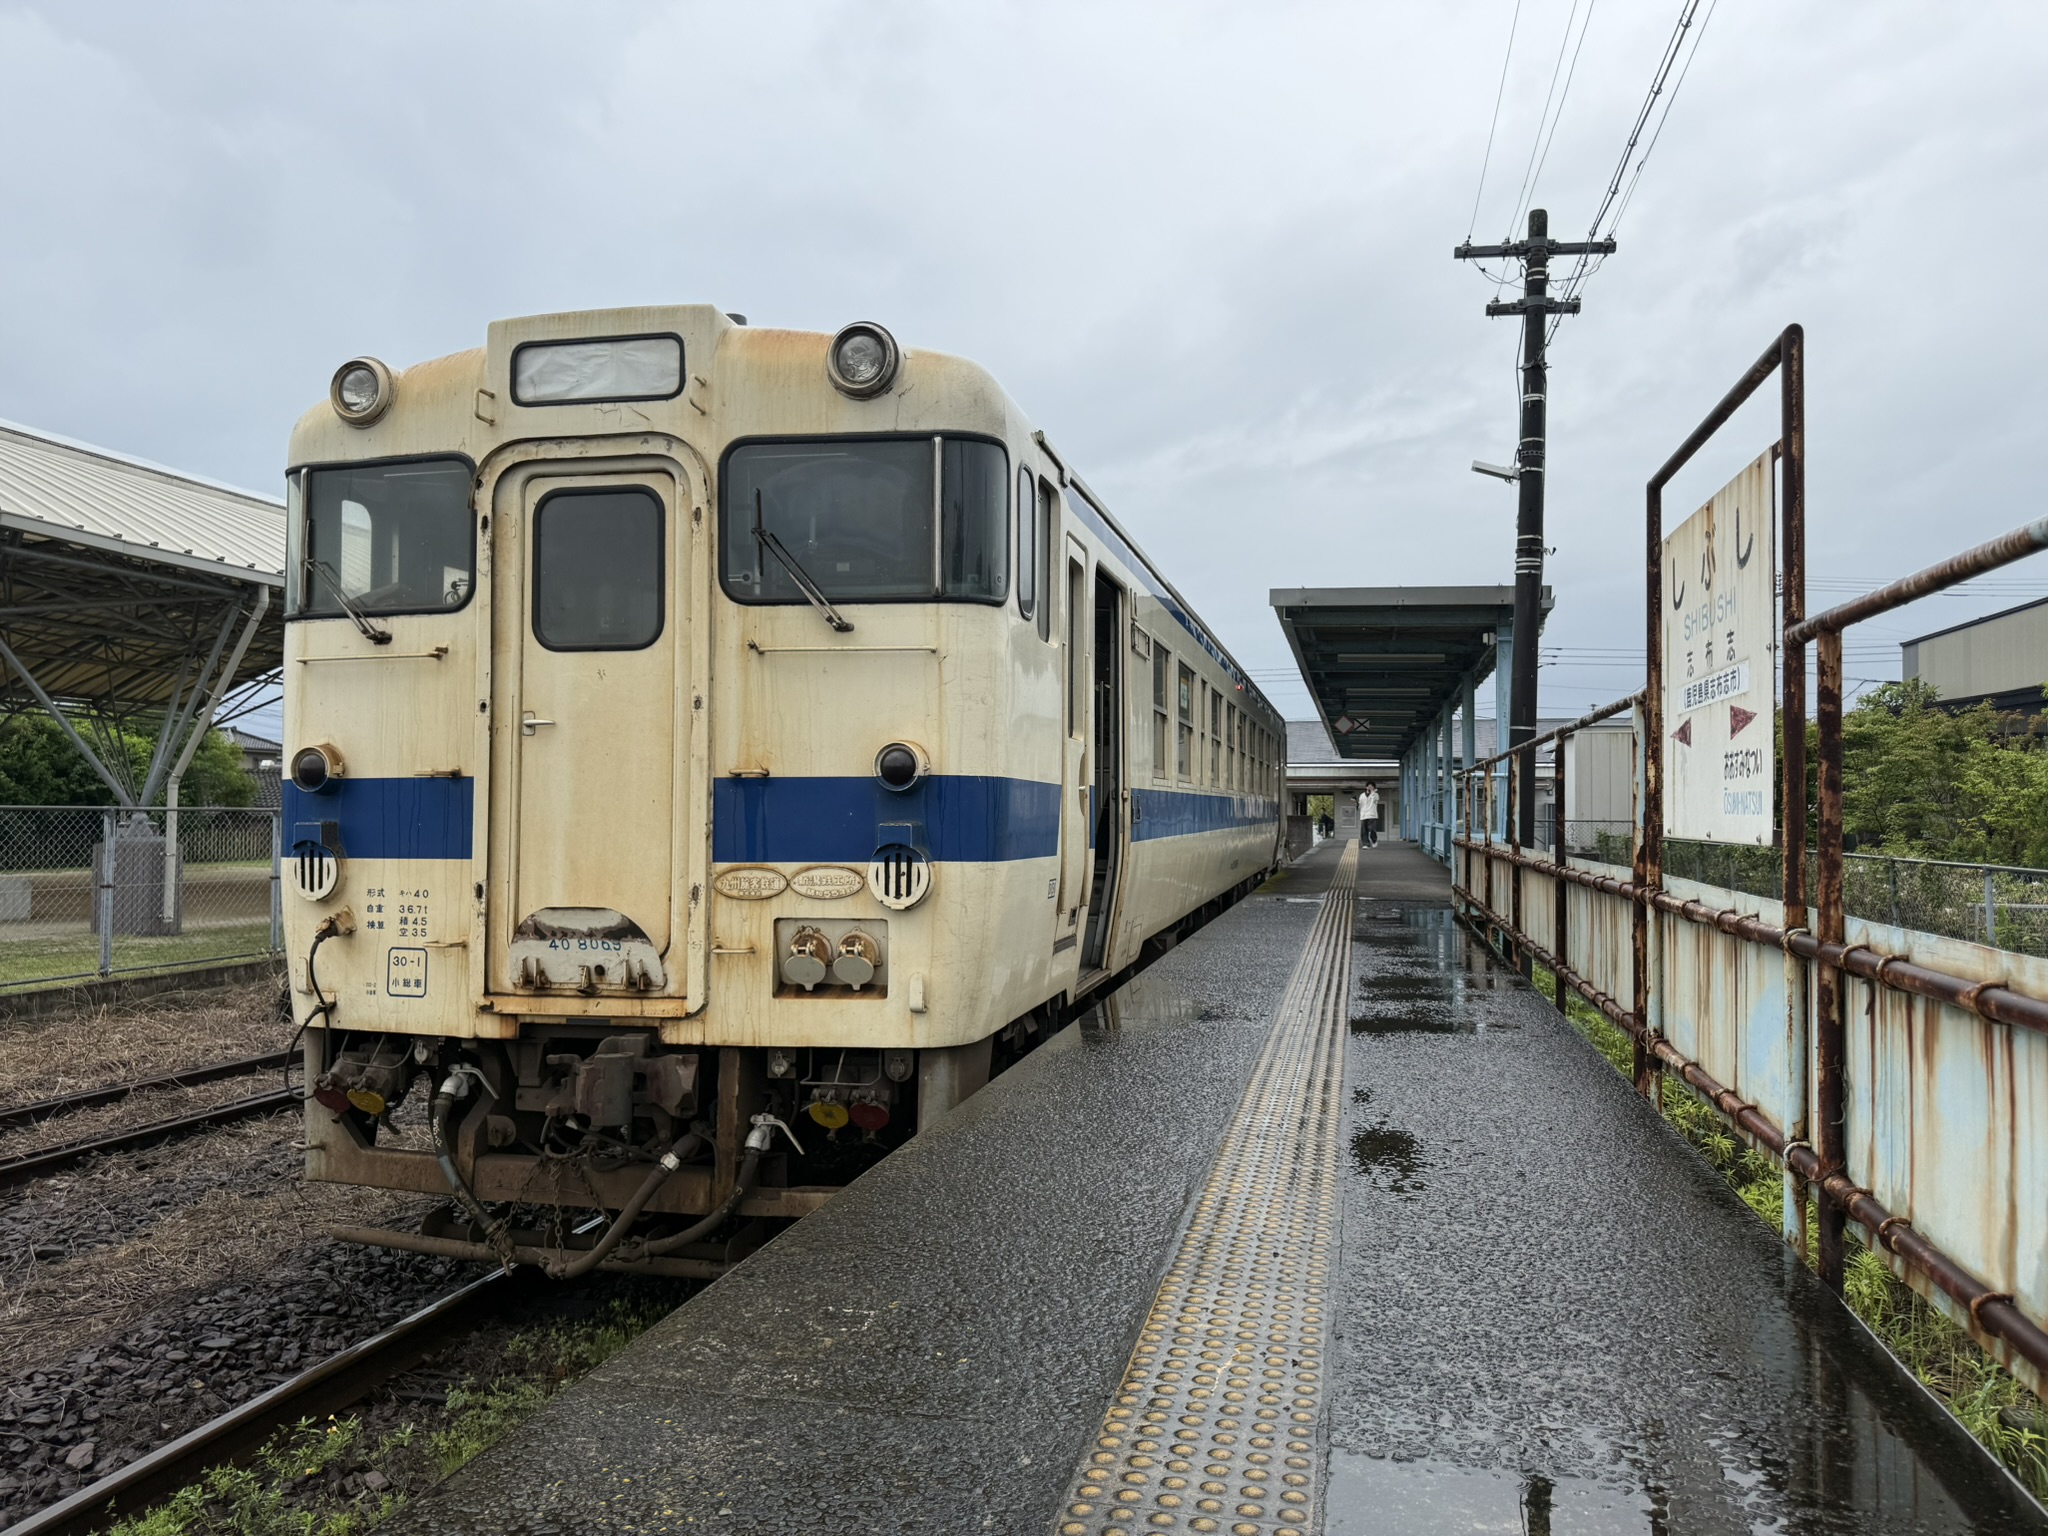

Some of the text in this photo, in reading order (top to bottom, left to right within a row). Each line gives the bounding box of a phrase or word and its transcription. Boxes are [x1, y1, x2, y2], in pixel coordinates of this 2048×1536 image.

[1672, 505, 1754, 611] しぶし
[1684, 585, 1737, 642] SHIBUSHI
[1686, 628, 1736, 678] 志布志
[366, 887, 429, 899] 形式 キハ40
[366, 903, 428, 914] 自重 36.7t
[412, 916, 427, 926] 4.5
[399, 927, 427, 937] 空 3.5
[548, 937, 570, 951] 40
[392, 955, 421, 967] 30-1
